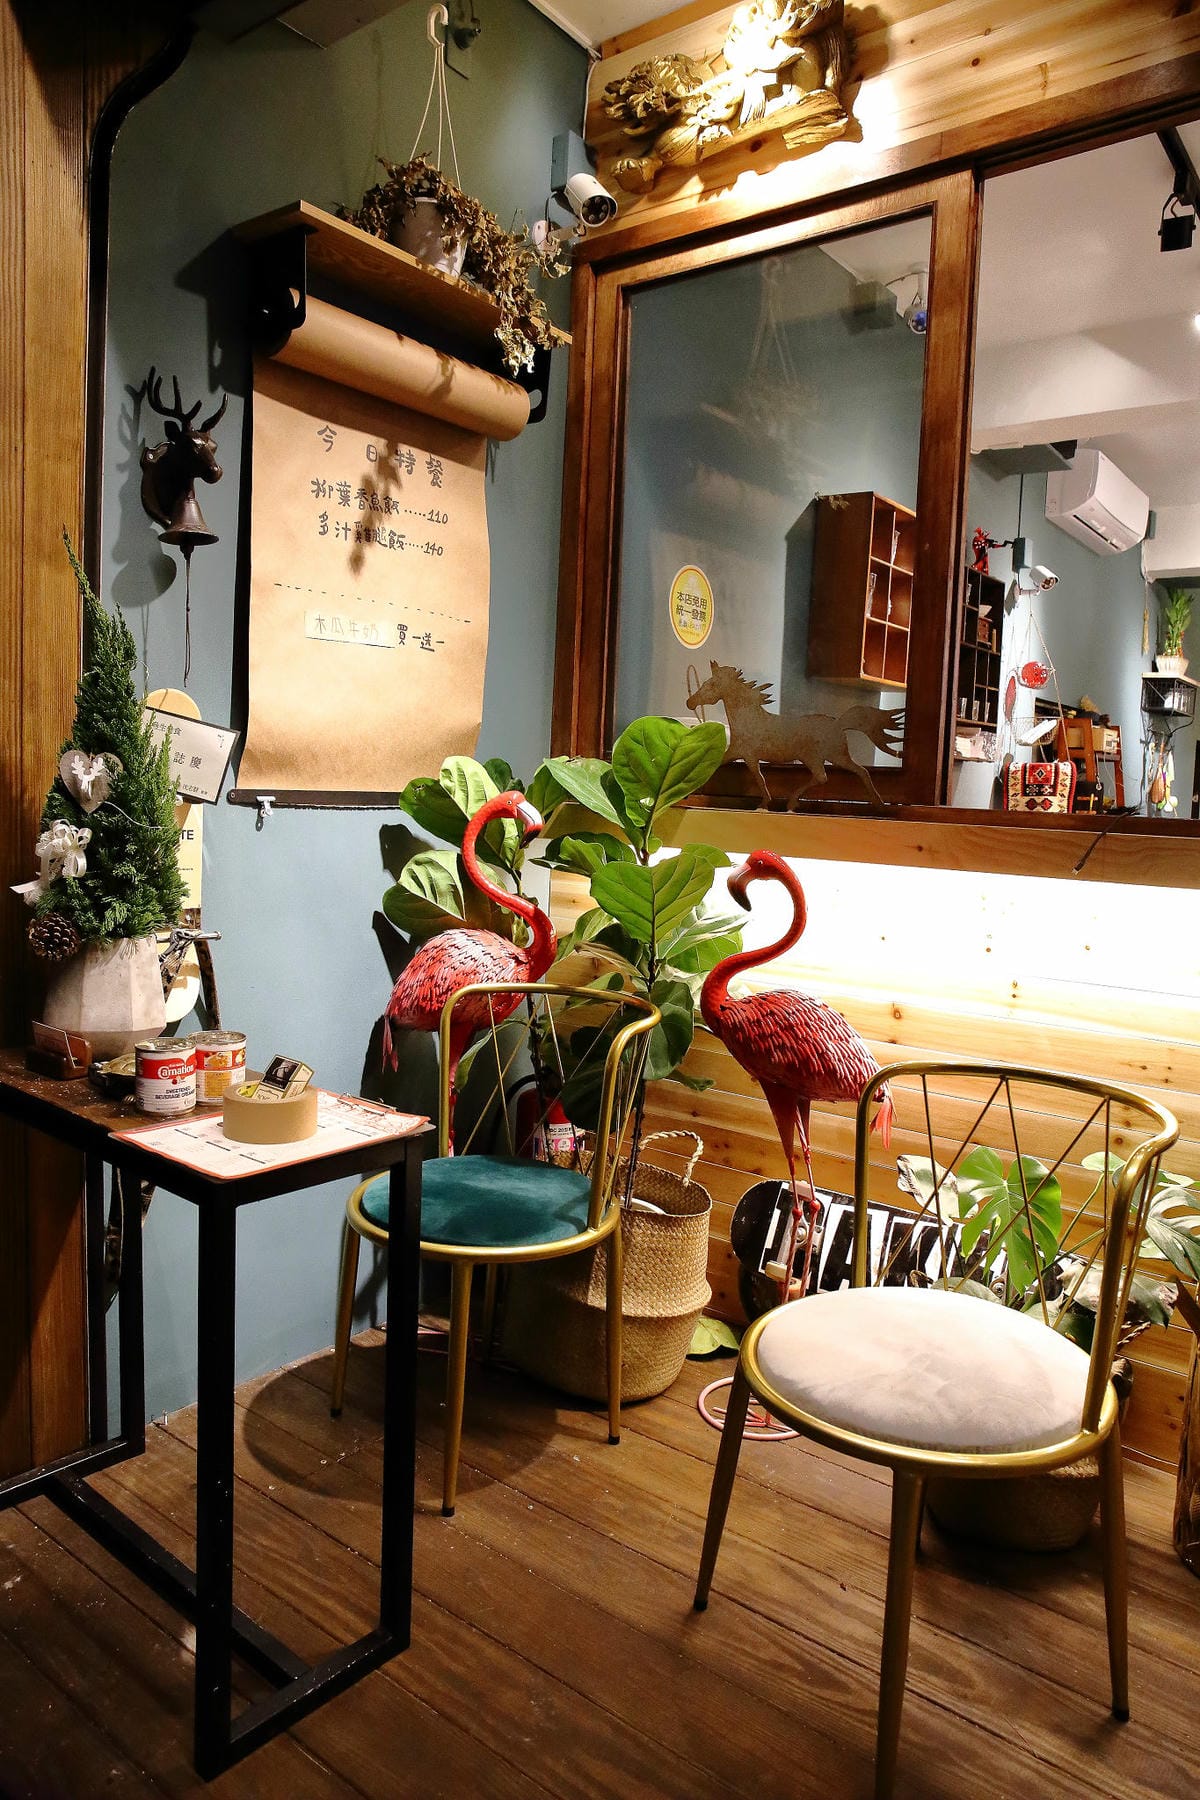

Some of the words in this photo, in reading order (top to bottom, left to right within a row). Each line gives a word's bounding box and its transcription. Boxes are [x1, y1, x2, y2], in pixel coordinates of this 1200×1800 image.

[317, 425, 444, 489] 今日特餐
[310, 477, 400, 516] 柳葉香魚飯
[427, 509, 449, 525] 110
[318, 511, 405, 551] 多汁雞腿飯
[423, 541, 444, 557] 140
[314, 613, 380, 640] 木瓜牛奶
[396, 623, 446, 653] 買一送一
